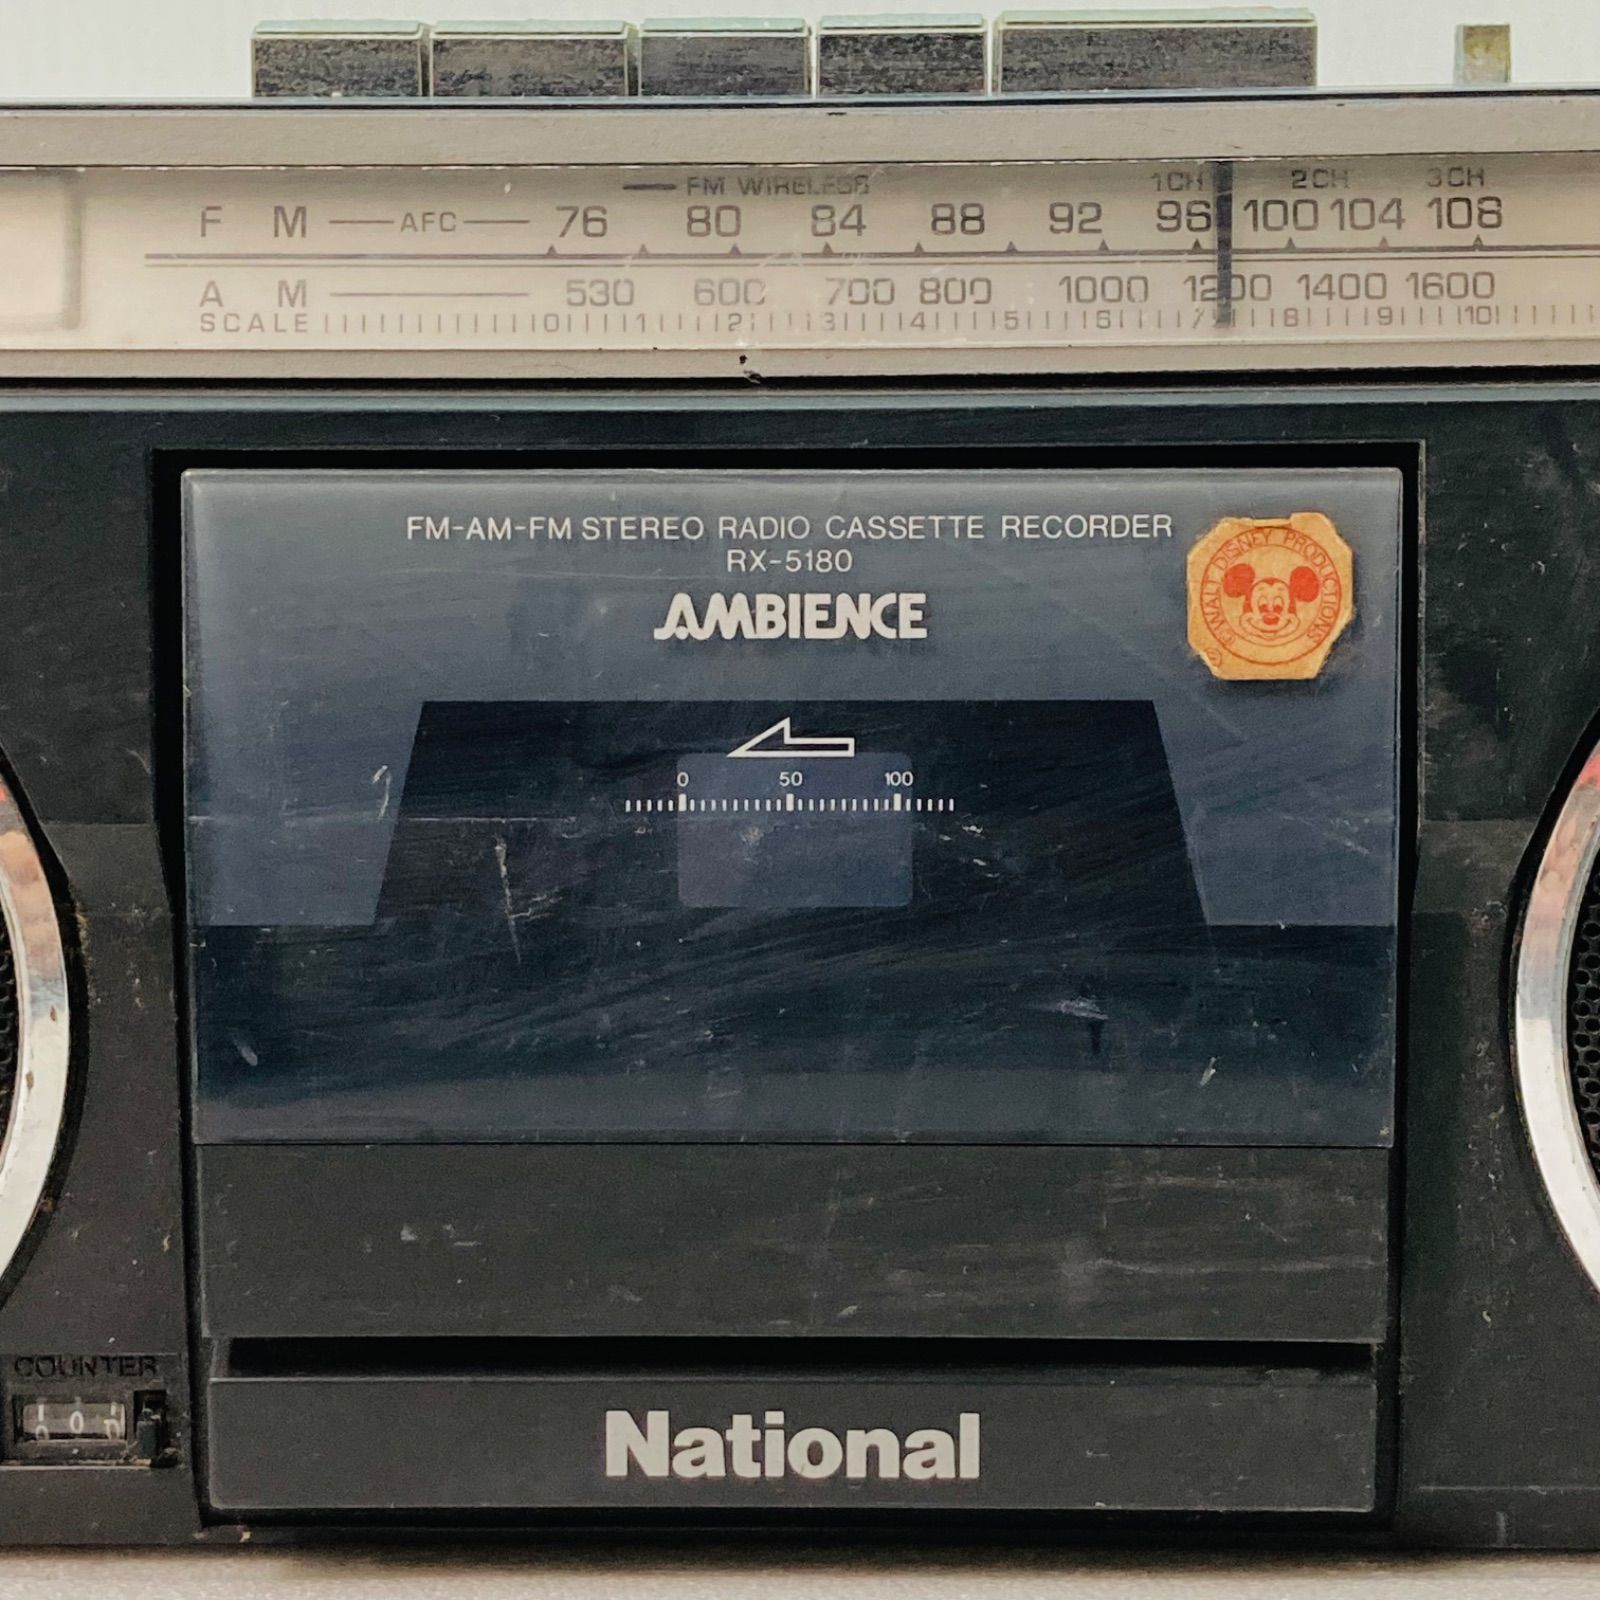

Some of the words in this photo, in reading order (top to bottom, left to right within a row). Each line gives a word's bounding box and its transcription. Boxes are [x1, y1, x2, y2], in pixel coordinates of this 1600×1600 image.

[687, 176, 726, 196] FM
[1151, 171, 1204, 192] 1CH
[1291, 168, 1350, 189] 2CH
[1426, 167, 1485, 188] 3CH
[400, 212, 458, 233] AFC
[555, 204, 609, 238] 76
[686, 204, 742, 237] 80
[811, 203, 867, 237] 84
[930, 202, 986, 235] 88
[1049, 201, 1104, 234] 92
[1156, 199, 1213, 233] 96
[1243, 198, 1319, 232] 100
[1330, 197, 1406, 231] 104
[1427, 196, 1503, 230] 108
[566, 278, 635, 307] 530
[694, 277, 767, 306] 600
[825, 277, 896, 306] 700
[919, 276, 993, 305] 800
[1059, 275, 1149, 304] 1000
[1297, 273, 1388, 301] 1400
[1406, 271, 1496, 300] 1600
[200, 313, 309, 334] SCALE
[406, 516, 573, 541] FM-AM-FM
[581, 515, 705, 541] STEREO
[718, 515, 811, 541] RADIO
[825, 515, 985, 541] CASSETTE
[1001, 513, 1174, 539] RECORDER
[726, 549, 853, 573] RX-5180
[1215, 529, 1273, 571] DISNEY
[1282, 529, 1340, 643] PRODUCTIONS
[653, 591, 928, 641] AMBIENCE
[676, 771, 690, 788] 0
[779, 771, 803, 788] 50
[884, 771, 914, 788] 100
[14, 1355, 158, 1378] COUNTER
[605, 1409, 981, 1481] National
